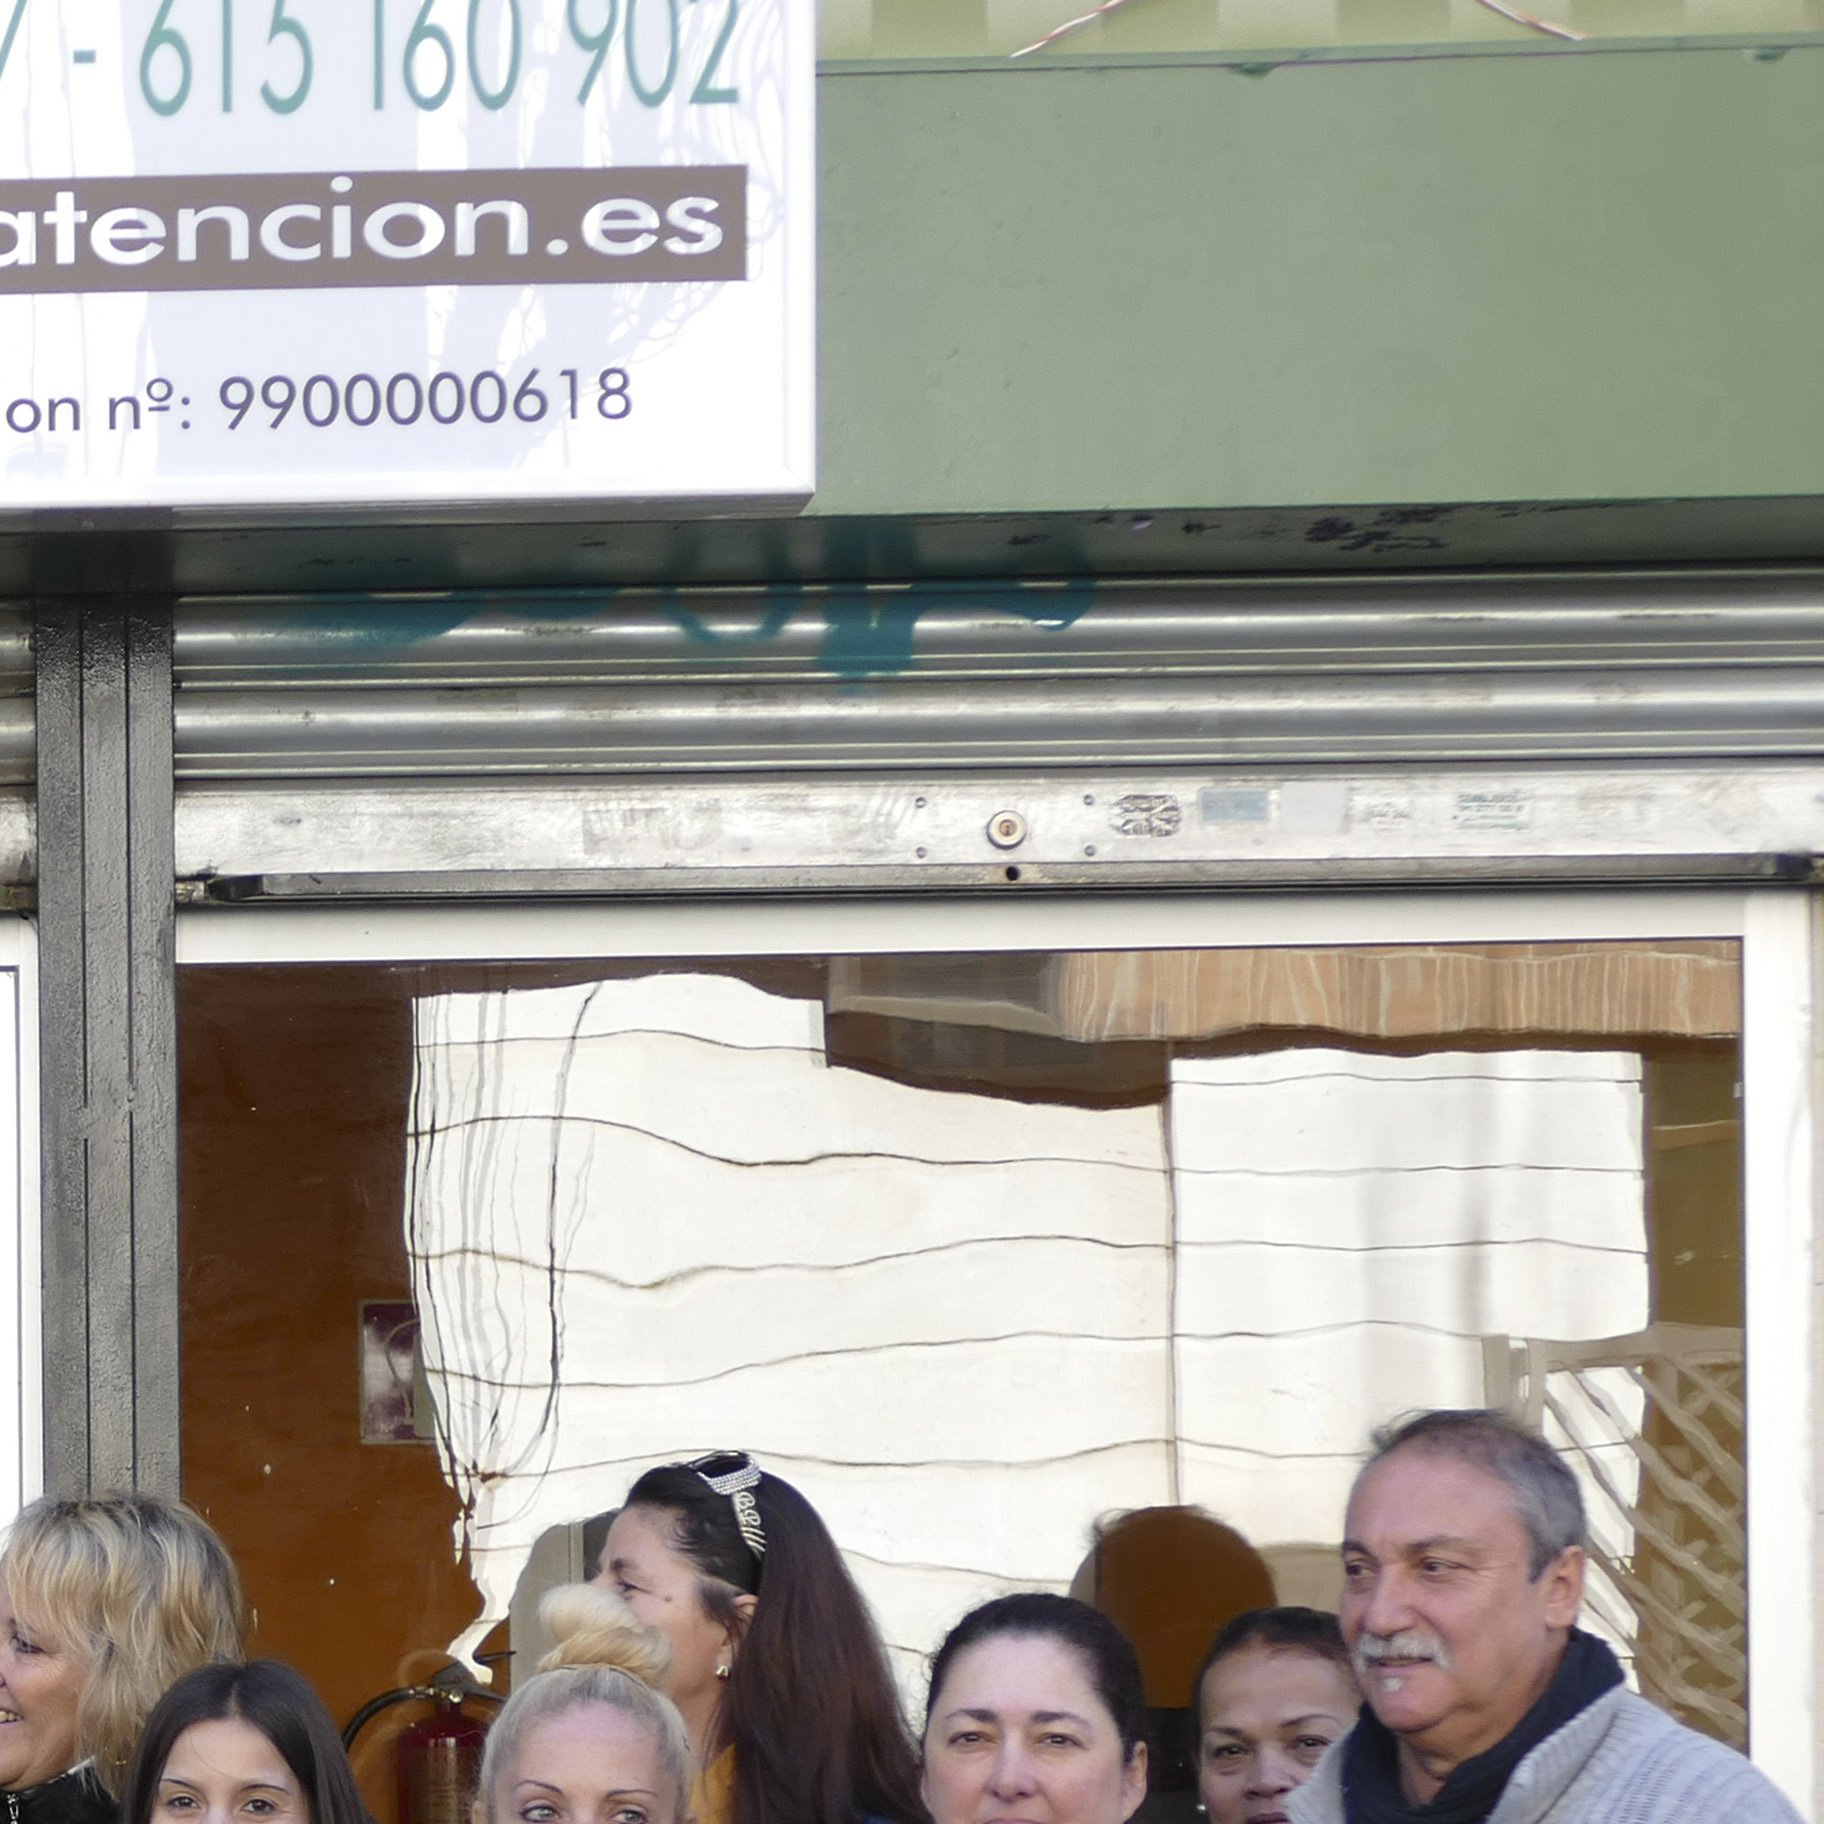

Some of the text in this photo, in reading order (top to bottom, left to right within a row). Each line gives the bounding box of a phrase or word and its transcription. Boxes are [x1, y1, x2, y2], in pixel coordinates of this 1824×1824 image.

[140, 0, 313, 117] 615
[373, 0, 522, 111] 160
[567, 0, 739, 108] 902
[220, 368, 630, 430] 9900000618
